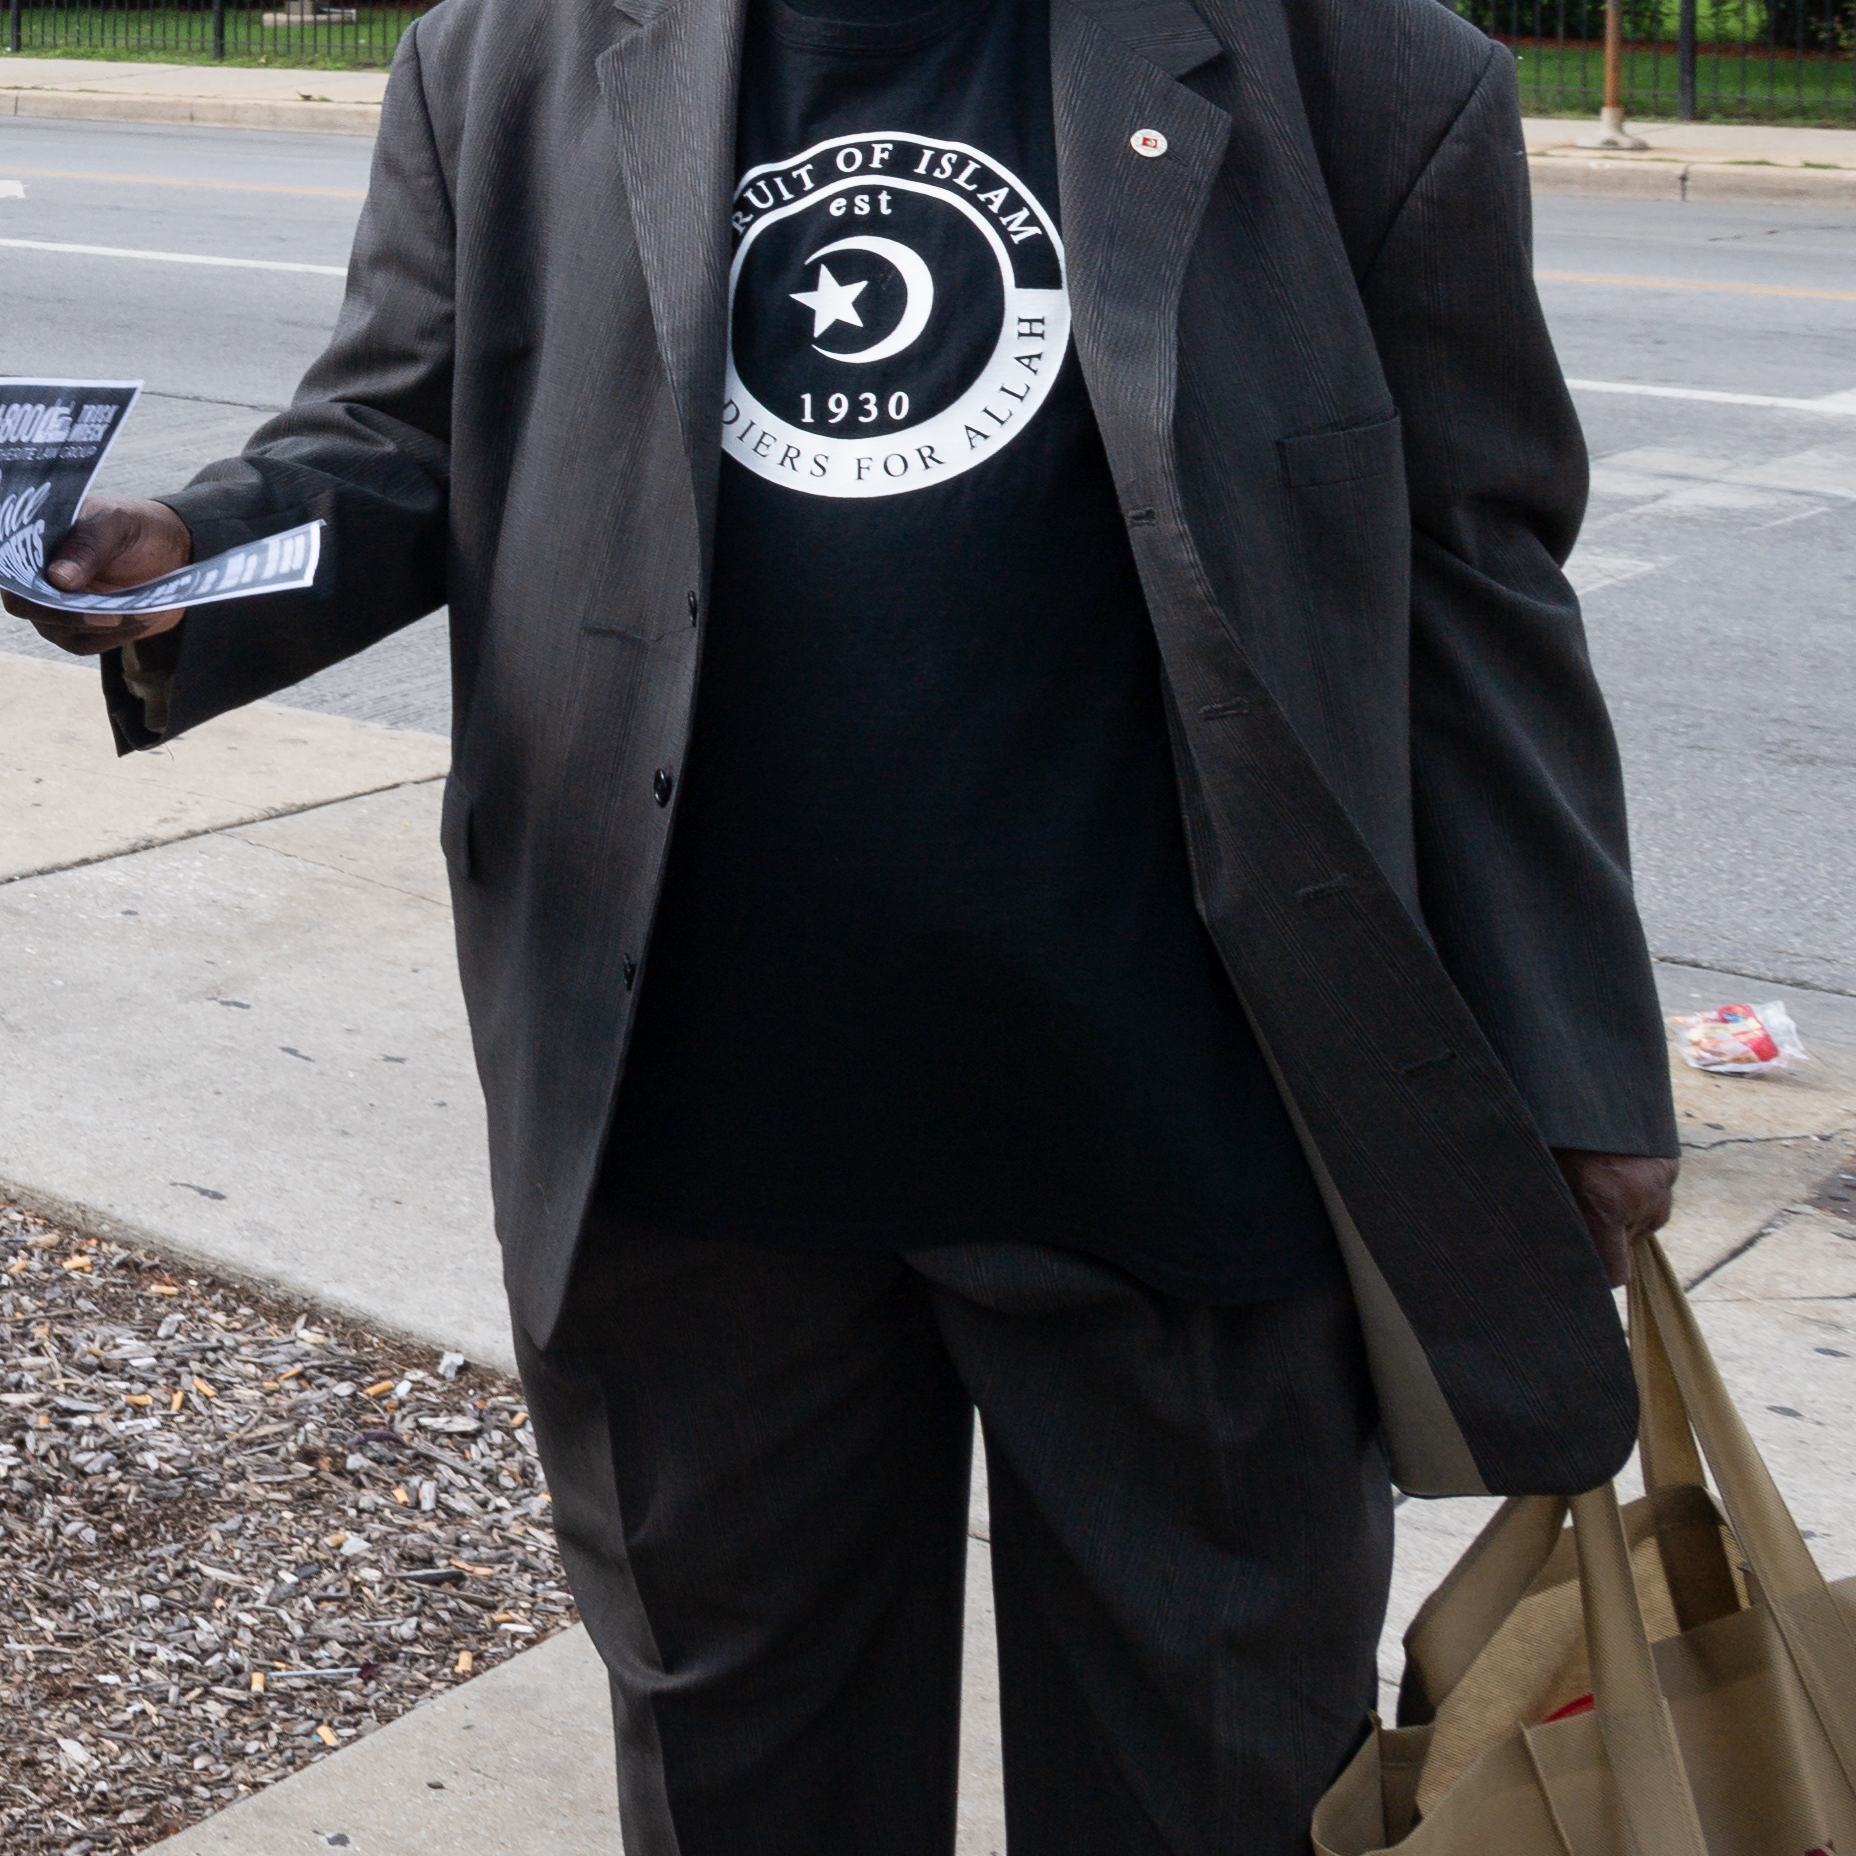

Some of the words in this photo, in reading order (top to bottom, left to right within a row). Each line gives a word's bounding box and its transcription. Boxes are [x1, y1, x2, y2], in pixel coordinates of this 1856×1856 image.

[829, 190, 892, 217] est
[836, 143, 893, 173] OF
[914, 148, 1043, 245] ISLAM
[800, 390, 910, 424] 1930
[855, 444, 946, 481] FOR
[962, 315, 1046, 450] ALLAH
